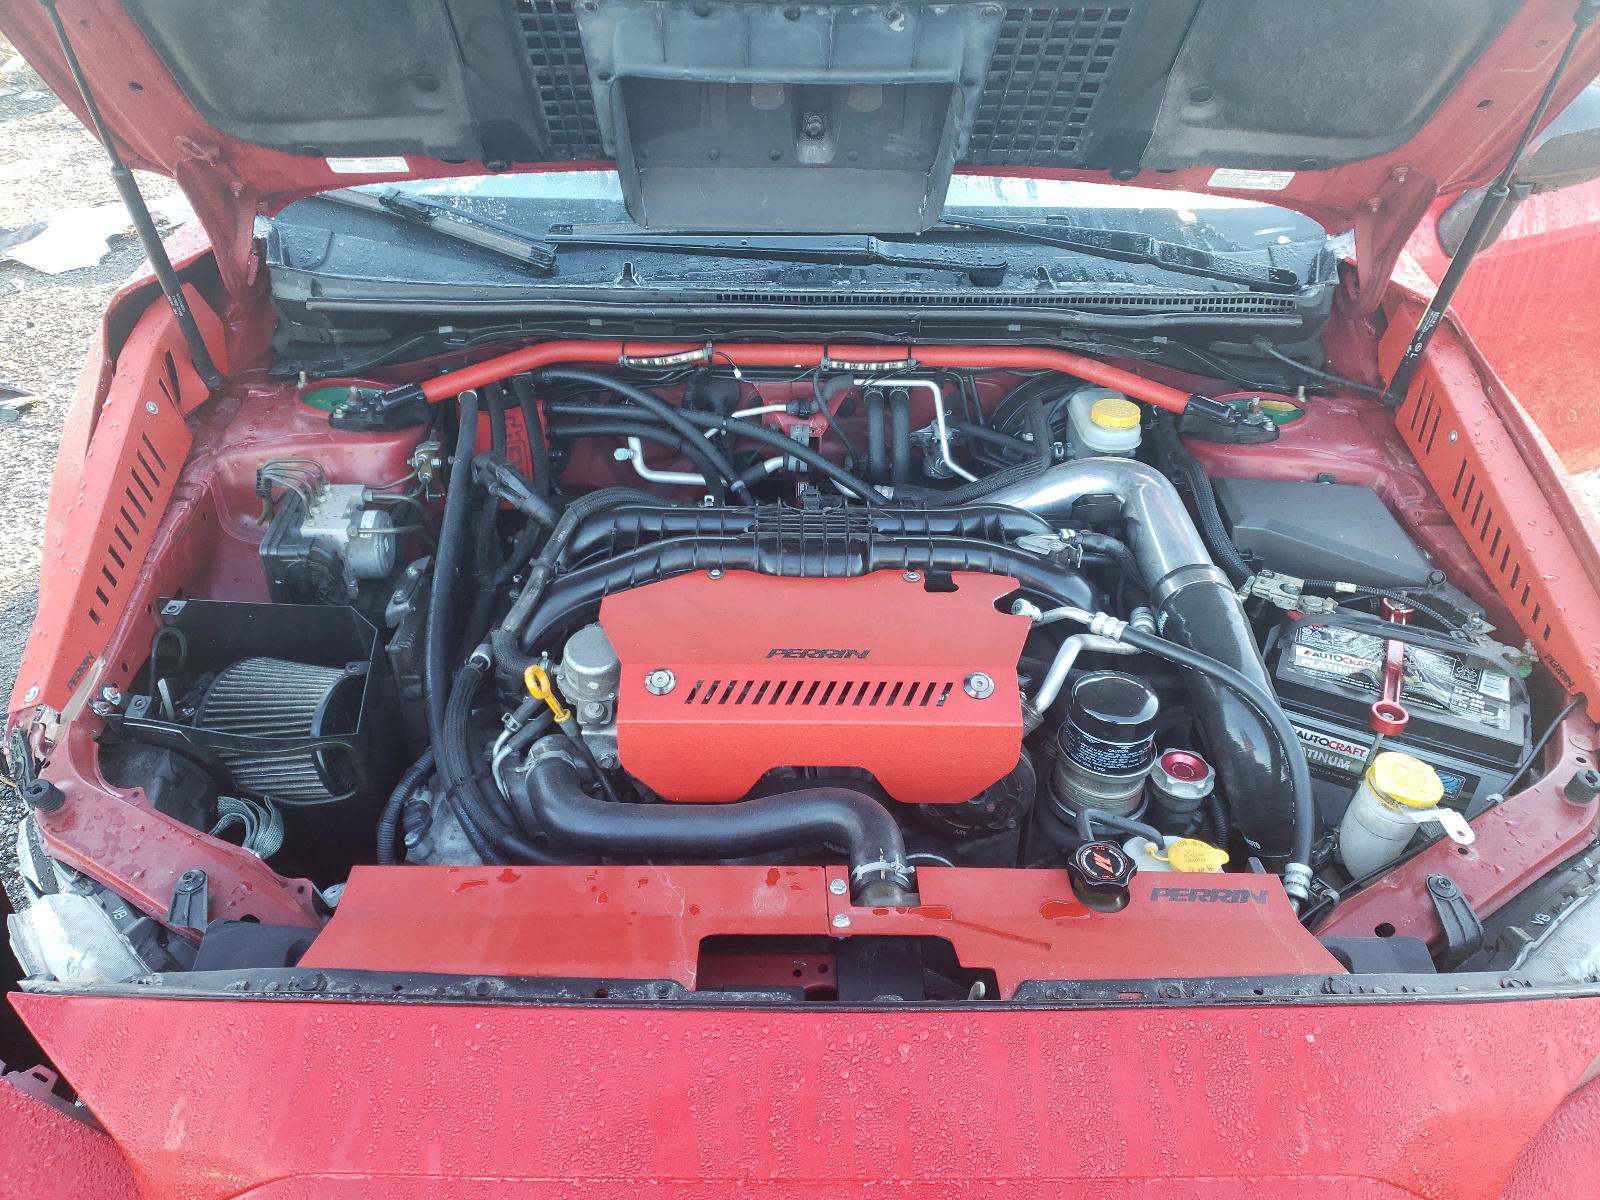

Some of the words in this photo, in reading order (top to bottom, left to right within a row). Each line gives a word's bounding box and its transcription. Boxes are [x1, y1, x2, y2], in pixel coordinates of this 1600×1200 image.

[766, 648, 871, 659] PERRIN
[1312, 651, 1372, 668] AUTOCRAF
[1296, 730, 1366, 757] AUTOCRAFT
[1302, 747, 1352, 770] TINUM
[1150, 887, 1269, 904] PERRIN
